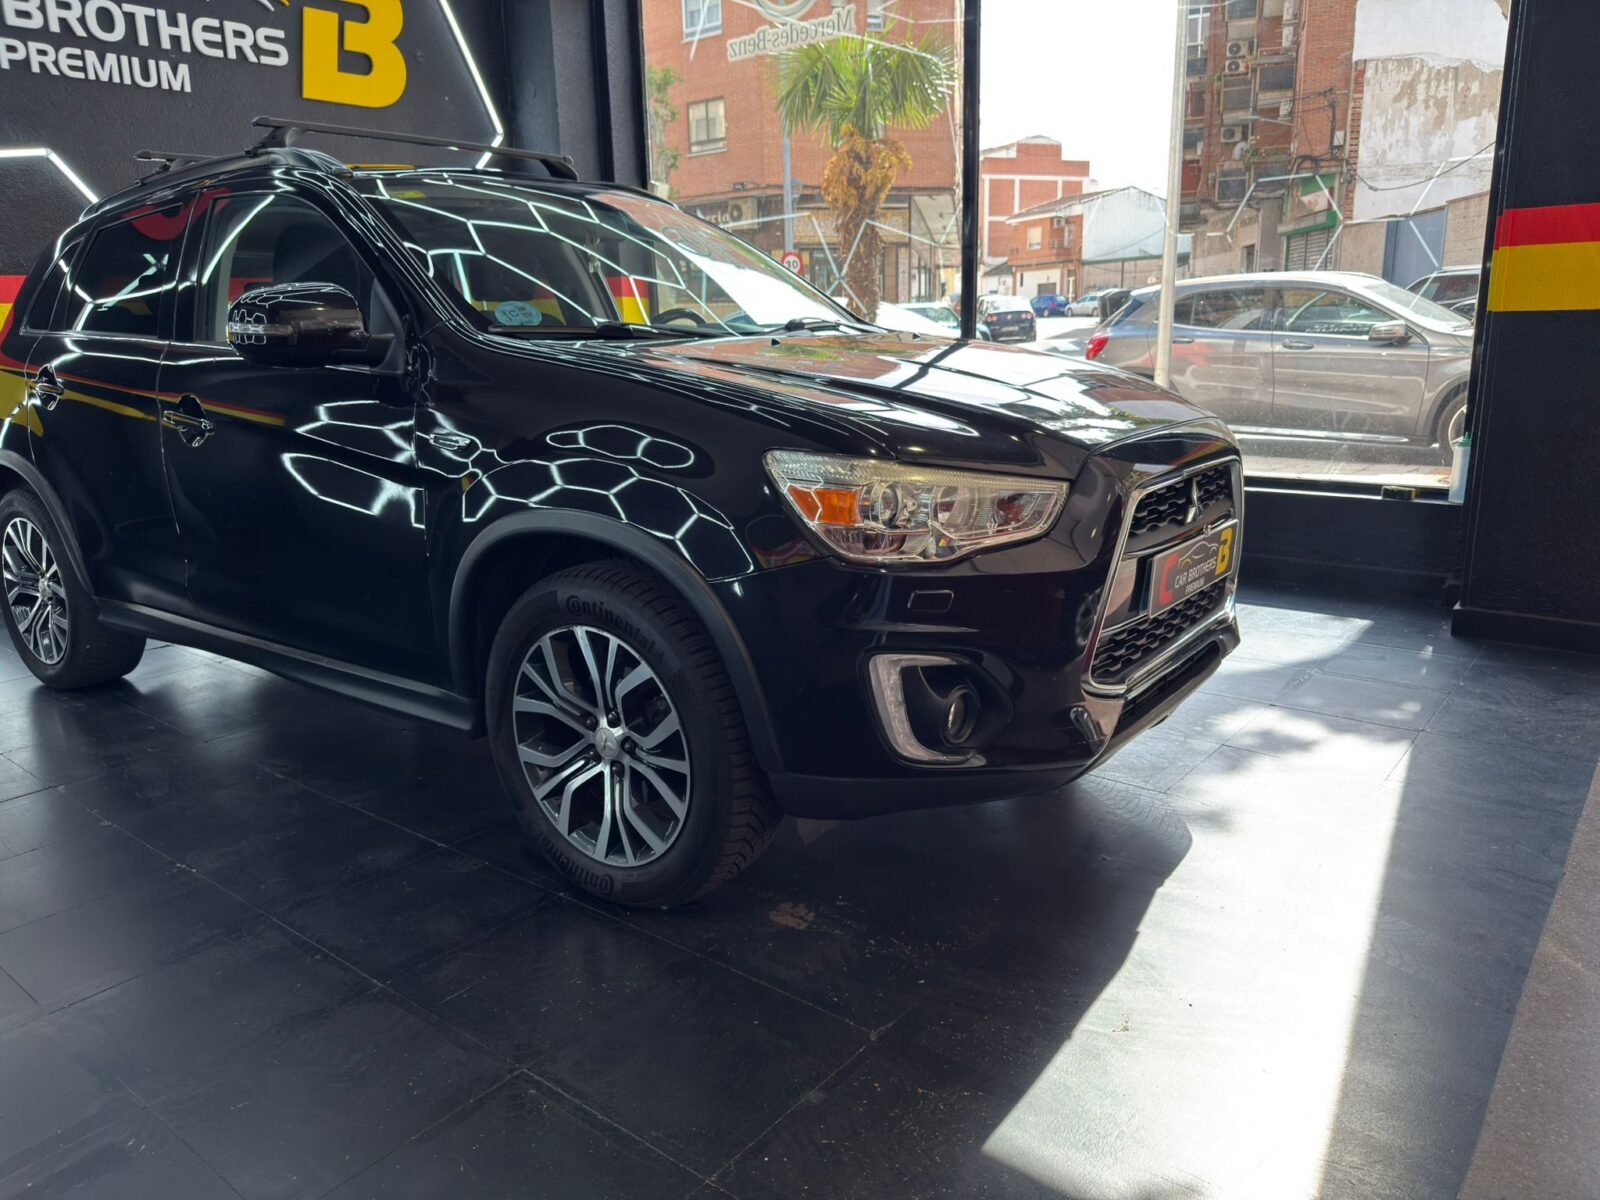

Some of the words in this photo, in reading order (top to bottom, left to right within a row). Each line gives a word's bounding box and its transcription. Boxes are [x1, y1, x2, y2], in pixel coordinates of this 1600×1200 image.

[2, 0, 289, 66] BROTHERS
[0, 37, 192, 93] PREMIUM
[785, 260, 799, 269] 30
[1174, 571, 1188, 589] CAR
[1187, 556, 1217, 582] BROTHERS
[1185, 577, 1204, 594] PREMIUM
[566, 595, 657, 653] Continental
